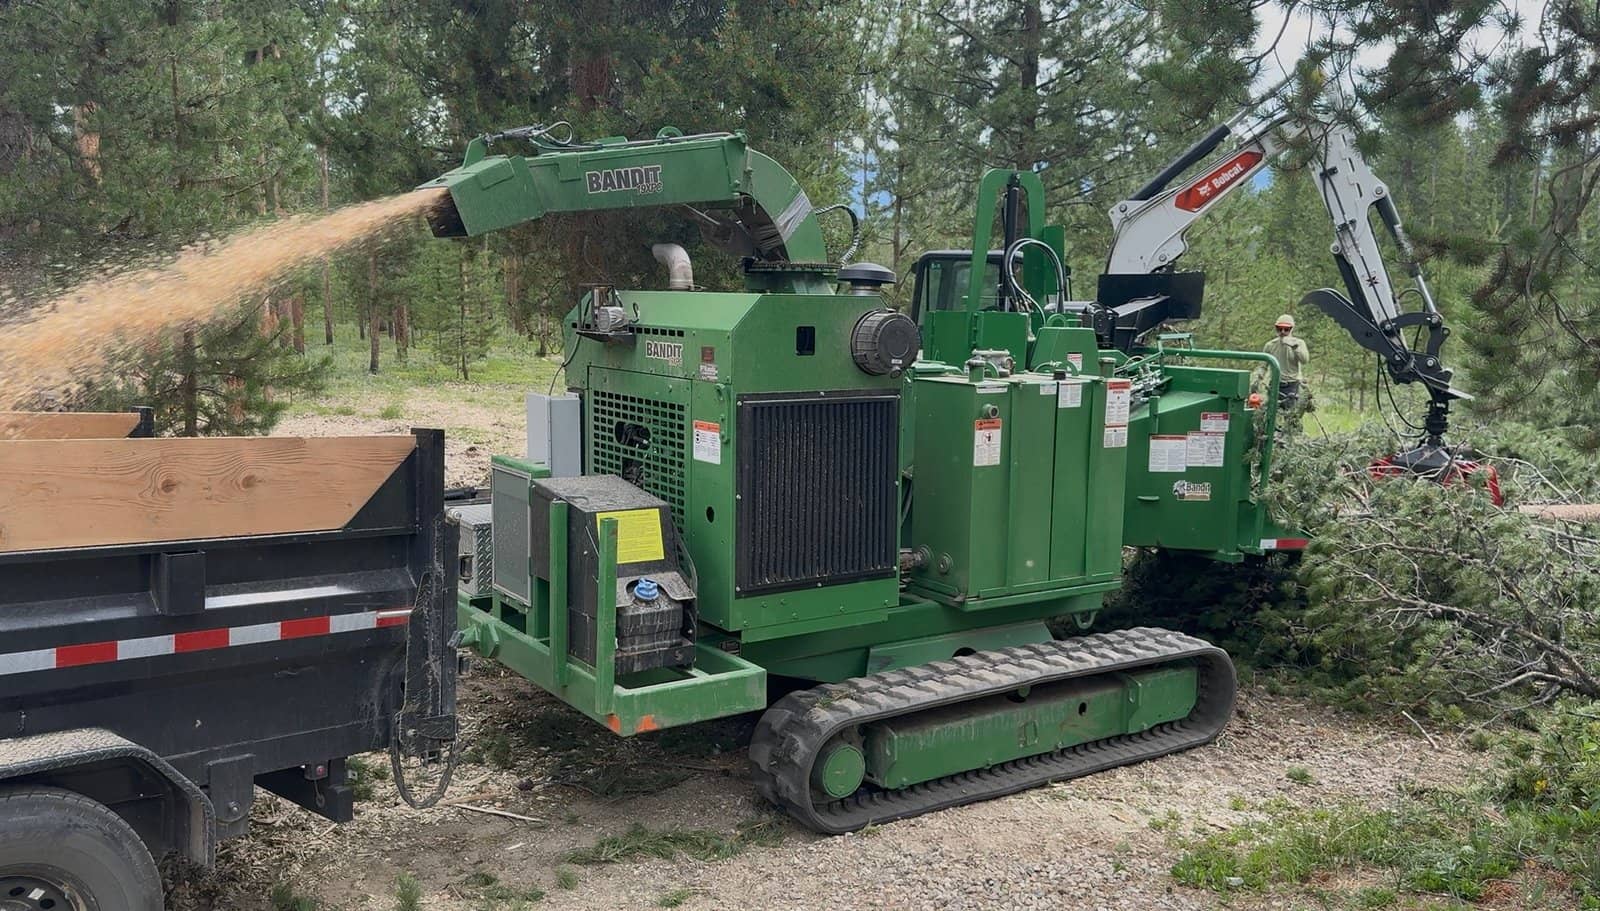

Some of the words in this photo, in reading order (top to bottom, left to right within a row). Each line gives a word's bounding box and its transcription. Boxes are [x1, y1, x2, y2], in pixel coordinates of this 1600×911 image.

[586, 166, 661, 193] BANDIT
[1211, 163, 1244, 189] Bobcat
[646, 341, 683, 360] BANDIT
